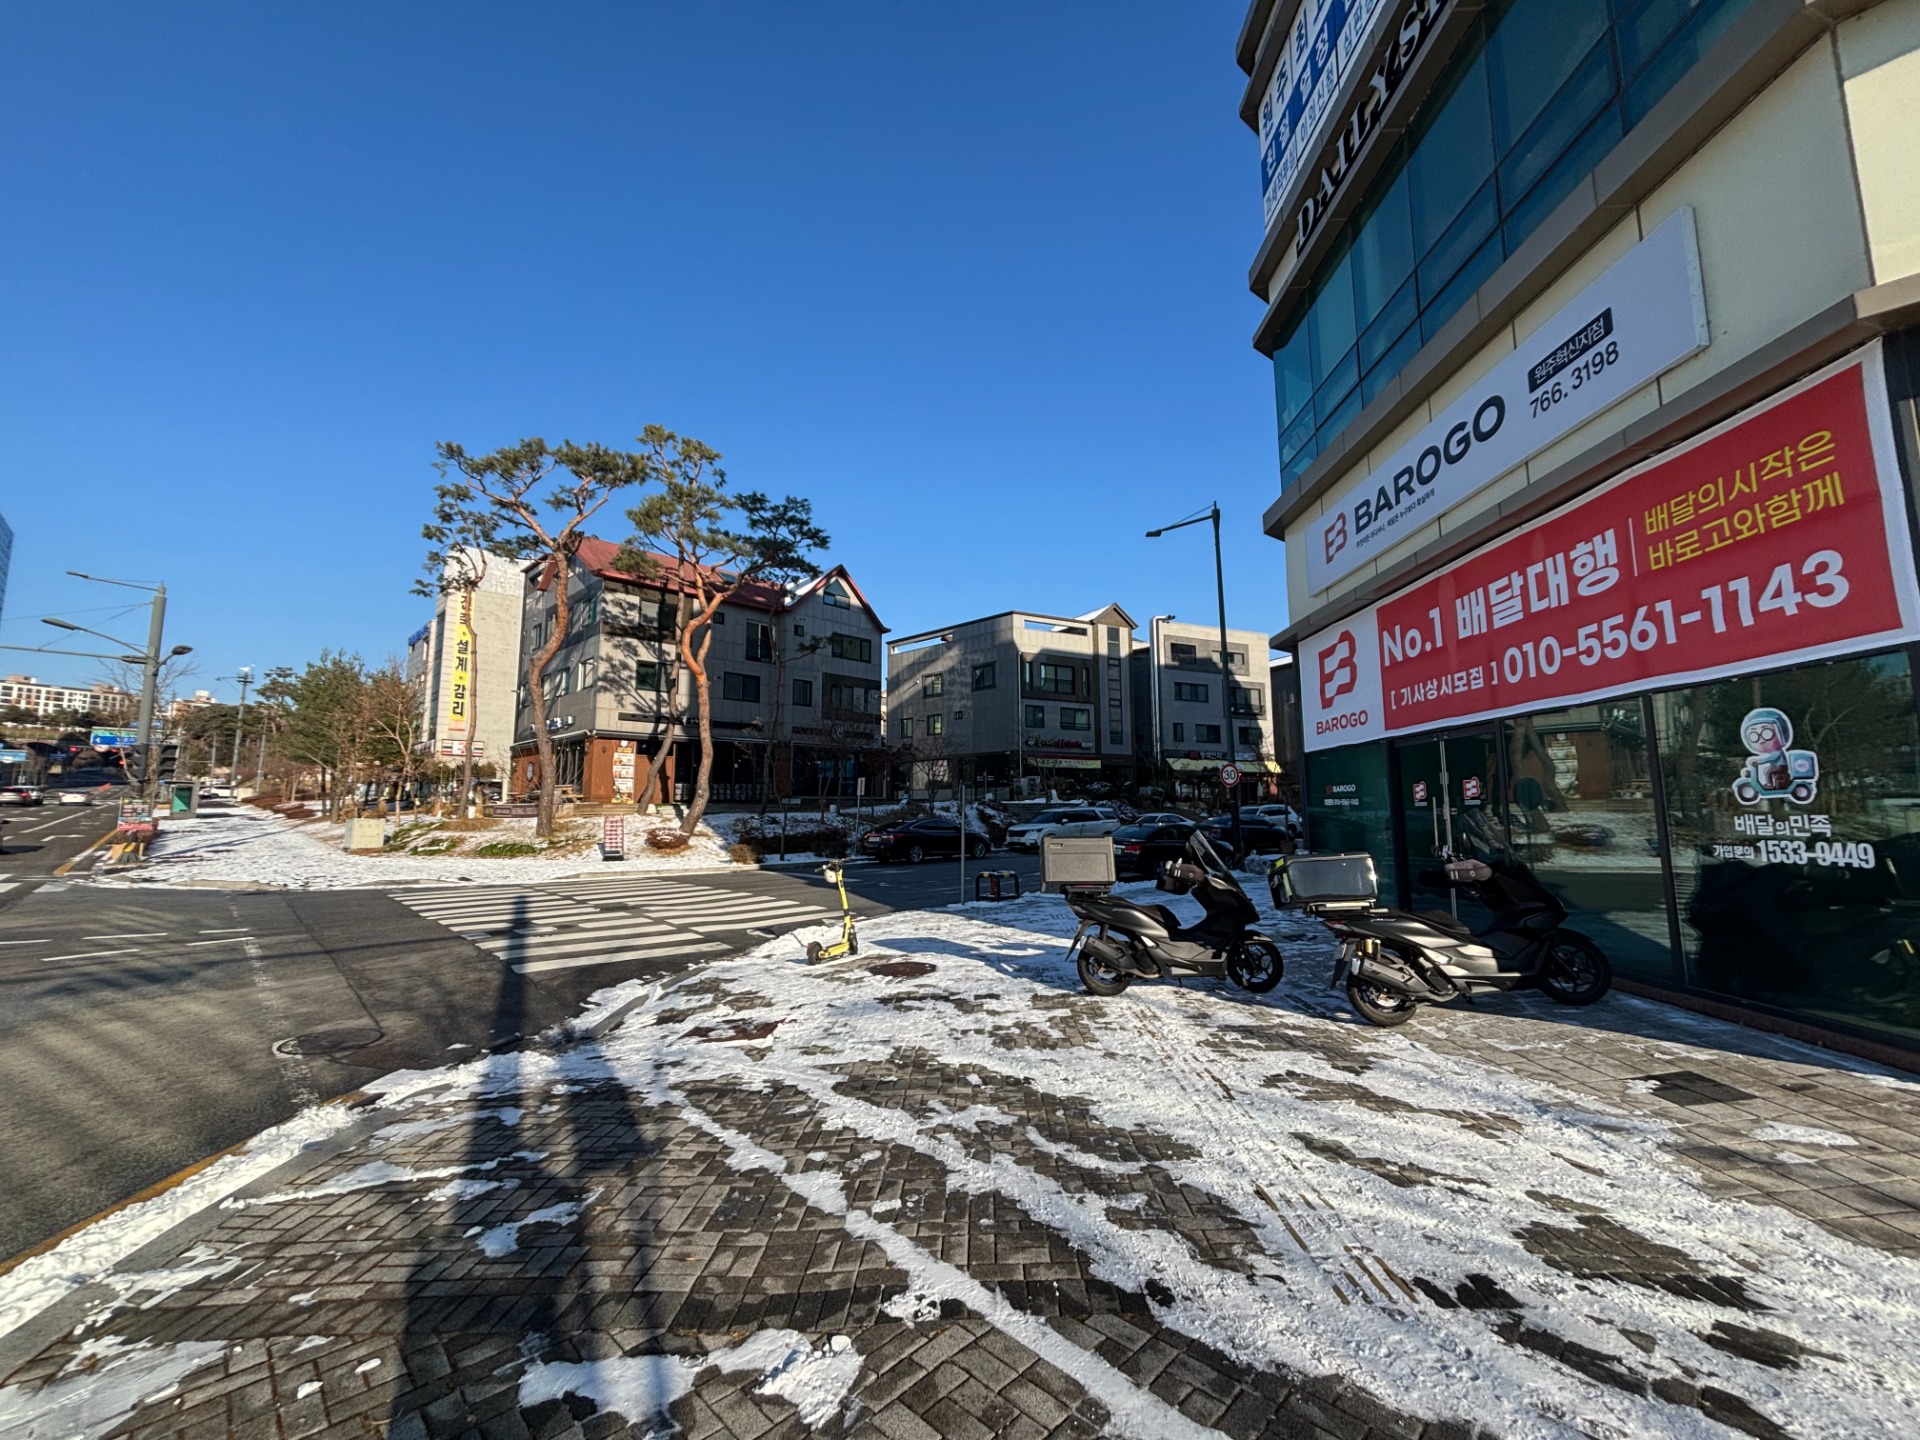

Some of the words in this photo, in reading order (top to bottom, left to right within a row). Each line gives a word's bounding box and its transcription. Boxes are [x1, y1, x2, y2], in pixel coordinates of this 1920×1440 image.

[1535, 317, 1605, 384] 원주혁신지점
[1354, 395, 1506, 535] BAROGO
[1382, 607, 1443, 667] No.1
[1456, 528, 1620, 640] 배달대행
[1503, 549, 1850, 684] 010-5561-1143
[1316, 710, 1369, 735] BAROGO
[1224, 769, 1236, 780] 30
[1332, 784, 1356, 793] BAROGO
[1734, 814, 1832, 837] 배달의민족
[1712, 845, 1755, 859] 가입문의
[1756, 840, 1876, 869] 1533-9449
